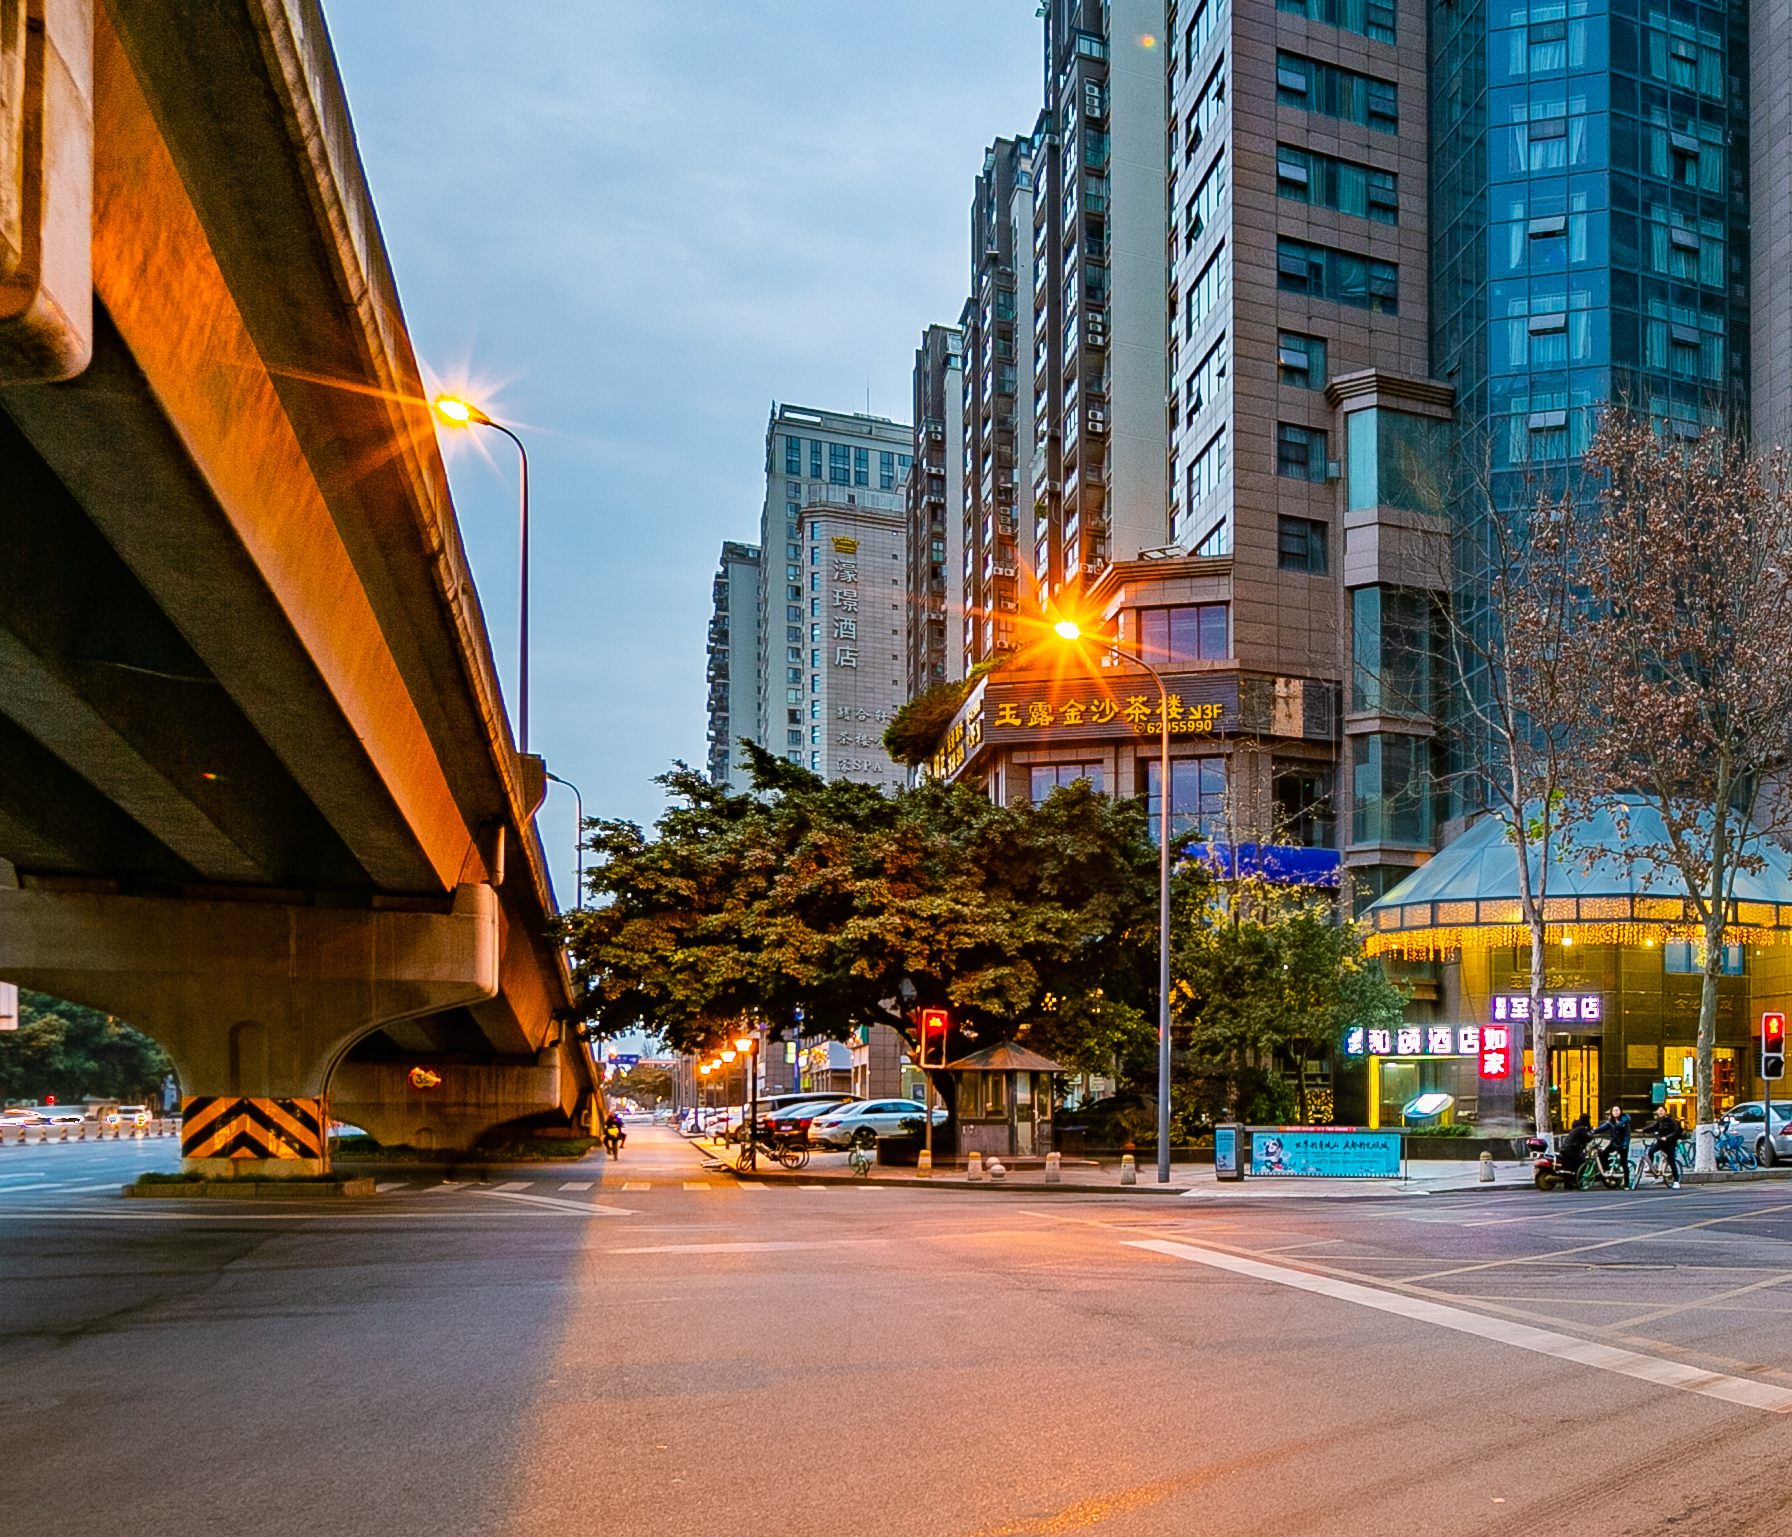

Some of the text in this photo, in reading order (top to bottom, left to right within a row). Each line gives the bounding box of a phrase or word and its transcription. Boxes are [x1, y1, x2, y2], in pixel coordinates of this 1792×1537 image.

[994, 694, 1185, 728] 玉露金沙茶楼
[1202, 704, 1223, 720] 3F
[1368, 1026, 1480, 1055] 和颐酒店
[1483, 1028, 1506, 1075] 如家
